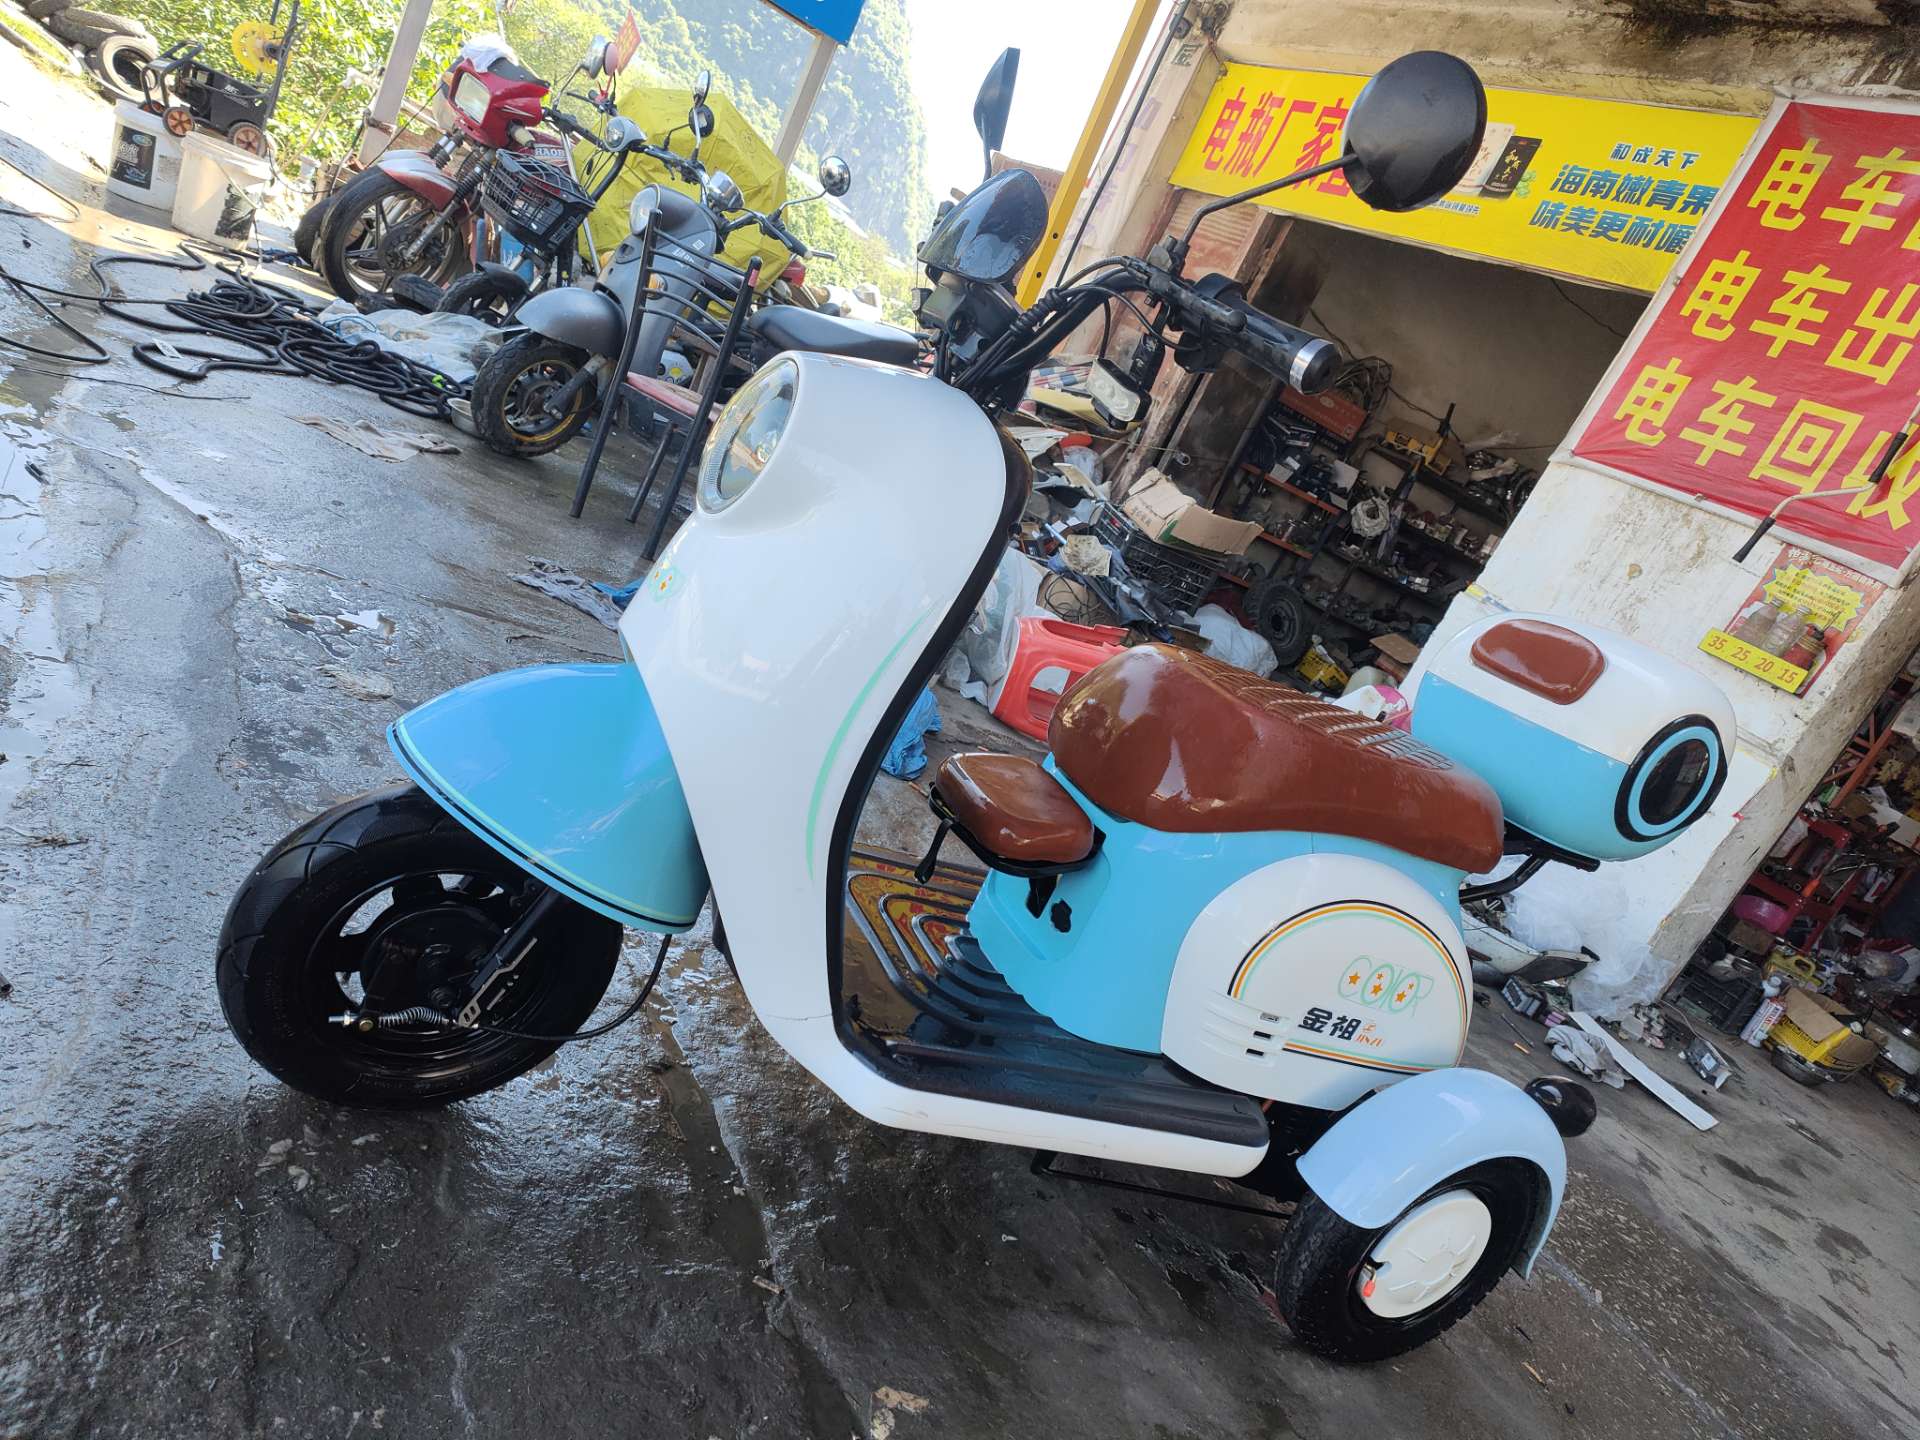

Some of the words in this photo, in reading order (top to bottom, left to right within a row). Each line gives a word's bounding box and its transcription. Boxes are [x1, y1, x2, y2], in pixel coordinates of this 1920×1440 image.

[1202, 87, 1350, 197] 电瓶厂家
[1610, 142, 1700, 170] 和成天下
[1550, 163, 1722, 216] 海南嫩青果
[1747, 136, 1920, 252] 电车
[1528, 199, 1697, 255] 味美更耐嚼
[1613, 357, 1920, 530] 电车回收
[1298, 1006, 1362, 1041] 金祖
